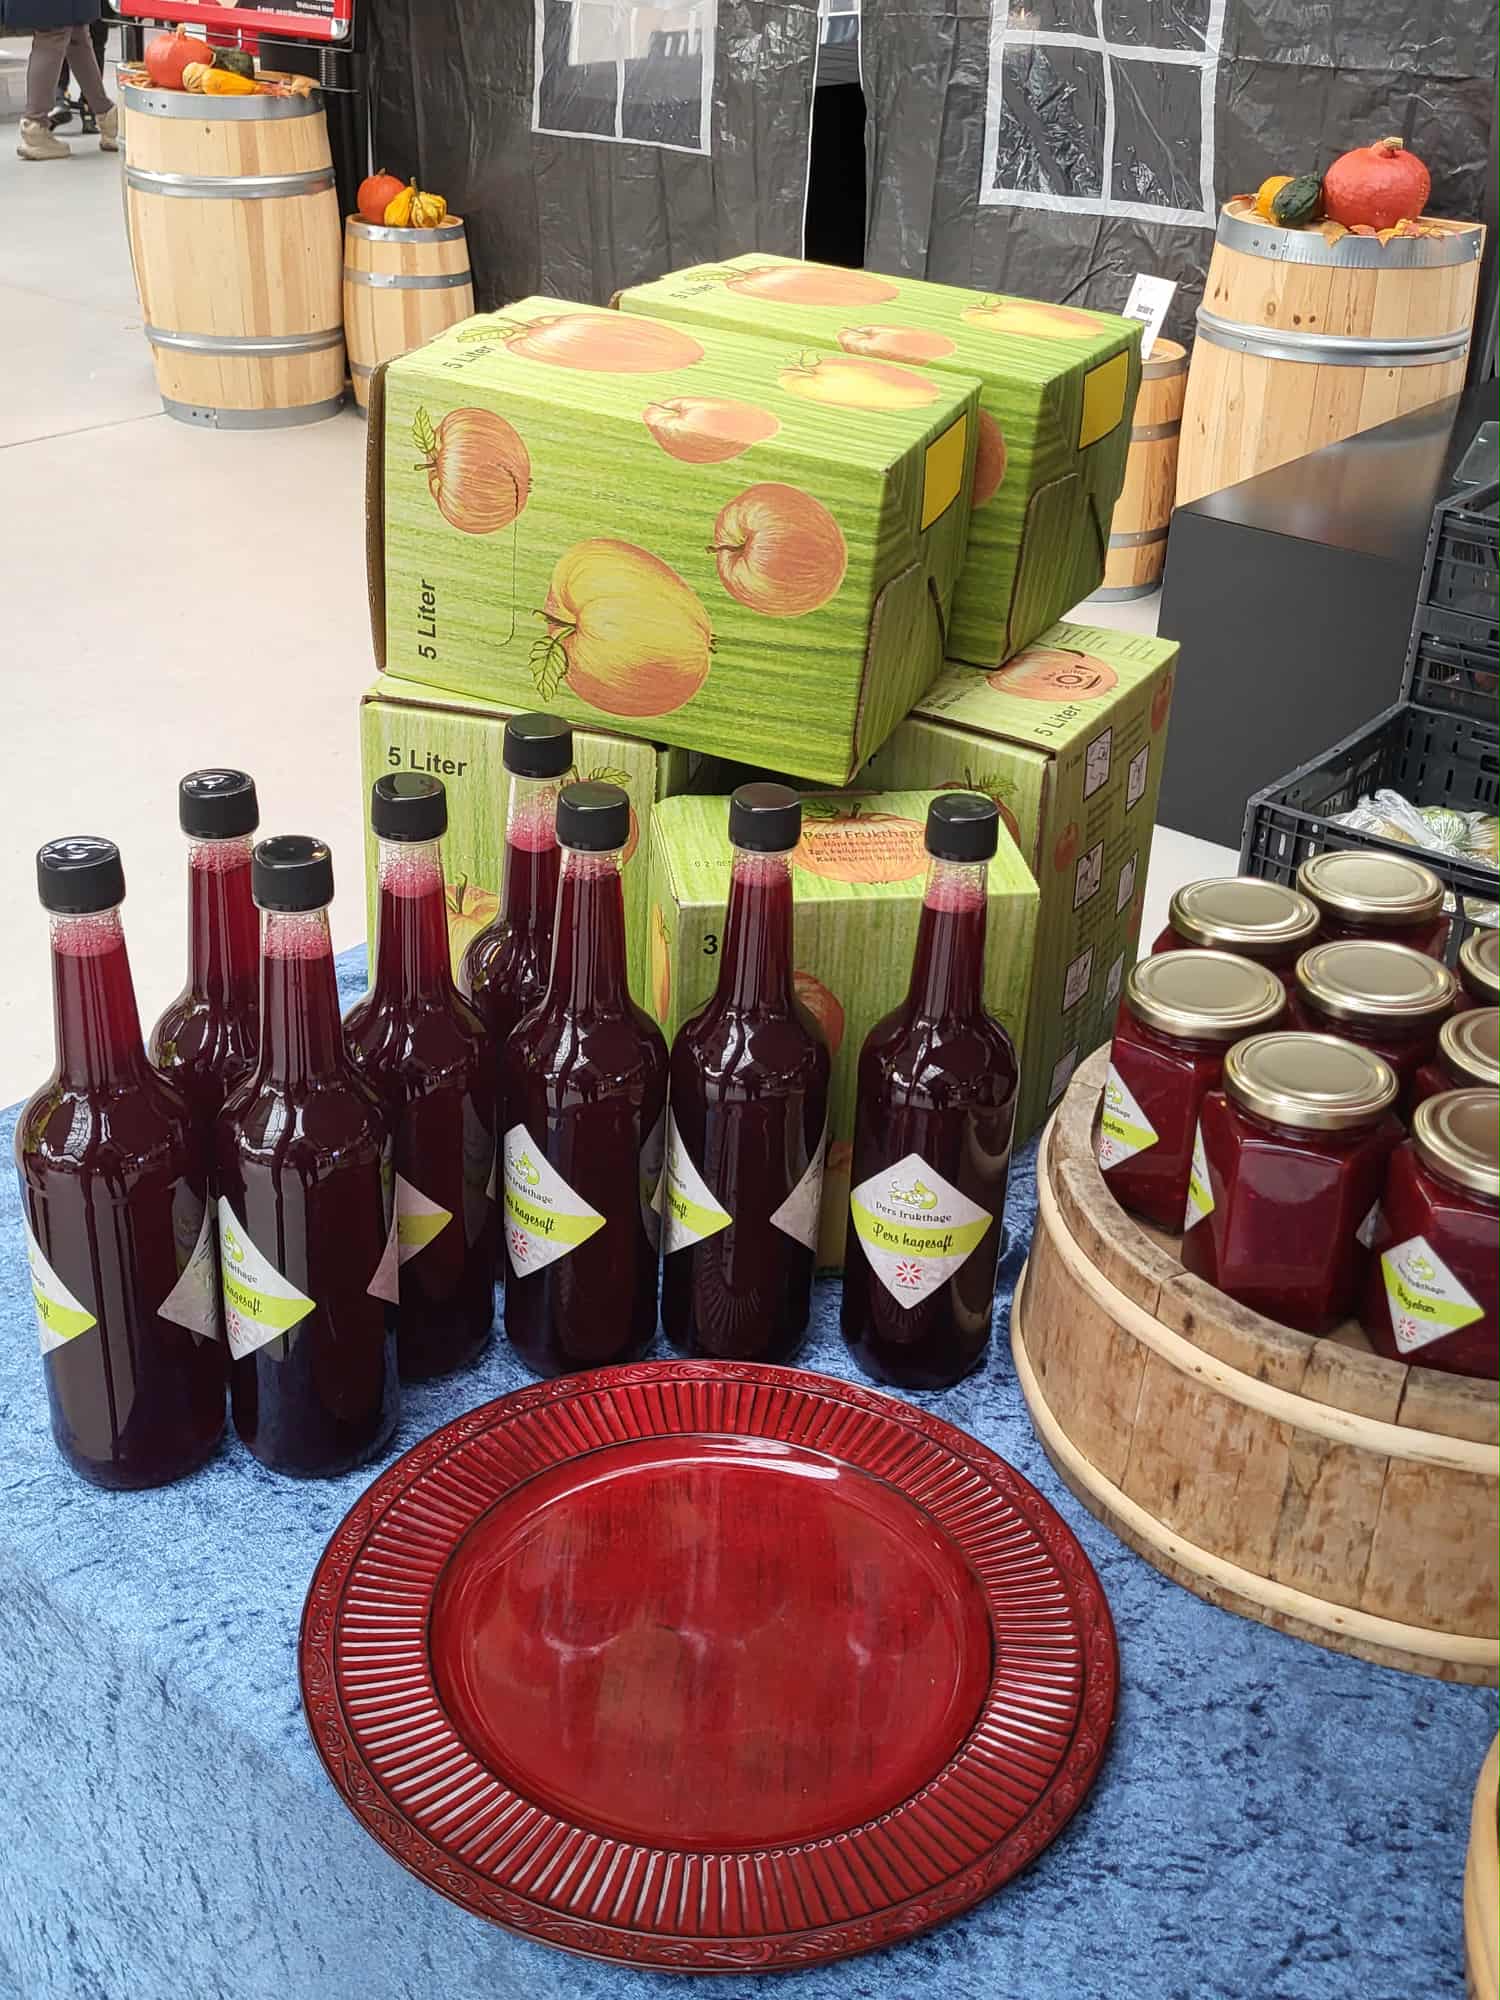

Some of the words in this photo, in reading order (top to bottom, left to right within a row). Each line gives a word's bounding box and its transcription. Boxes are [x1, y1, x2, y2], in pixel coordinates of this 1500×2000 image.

[679, 284, 718, 296] Liter
[450, 345, 498, 363] Liter
[442, 361, 465, 369] 5
[417, 578, 436, 639] Liter
[418, 645, 437, 660] 5
[1042, 704, 1082, 729] Liter
[1033, 726, 1054, 737] 5
[388, 745, 402, 767] 5
[410, 749, 468, 777] Liter
[803, 831, 842, 841] Pers
[702, 933, 719, 955] 3
[875, 1200, 898, 1217] Pers
[515, 1201, 556, 1235] hagesaft
[872, 1221, 900, 1244] Pers
[902, 1232, 954, 1254] hagesaft
